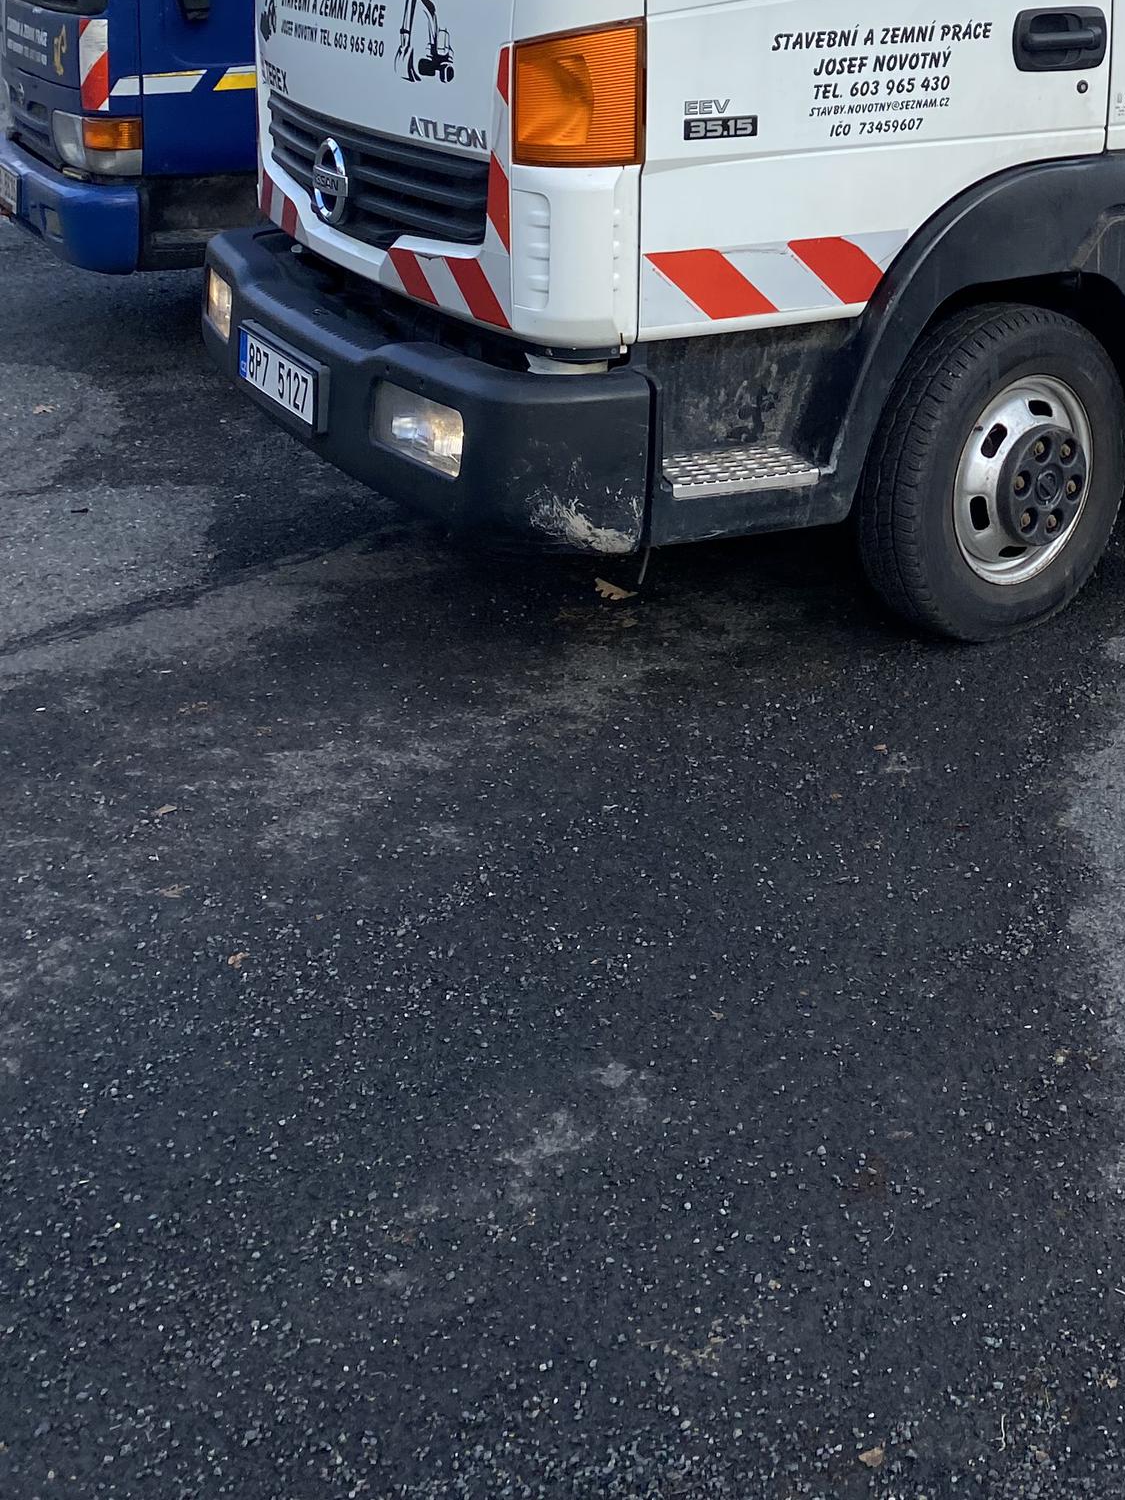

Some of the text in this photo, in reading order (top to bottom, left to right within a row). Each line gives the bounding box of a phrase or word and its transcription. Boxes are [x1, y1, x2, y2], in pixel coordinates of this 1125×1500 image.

[333, 32, 347, 51] 603
[350, 38, 365, 54] 965
[367, 40, 384, 58] 430
[771, 19, 993, 51] STAVEBNÍ A ZEMNÍ PRÁCE
[813, 46, 952, 76] JOSEF NOVOTNÝ
[813, 75, 950, 100] TEL. 603 965 430
[684, 99, 731, 116] EEV
[808, 97, 950, 117] STAVBY.NOVOTNY@SEZNAM.CZ
[409, 115, 487, 151] ATLEON
[689, 118, 753, 138] 35.15
[829, 118, 924, 138] IČO 73459607
[249, 342, 270, 387] 8P7
[278, 361, 309, 413] 5127
